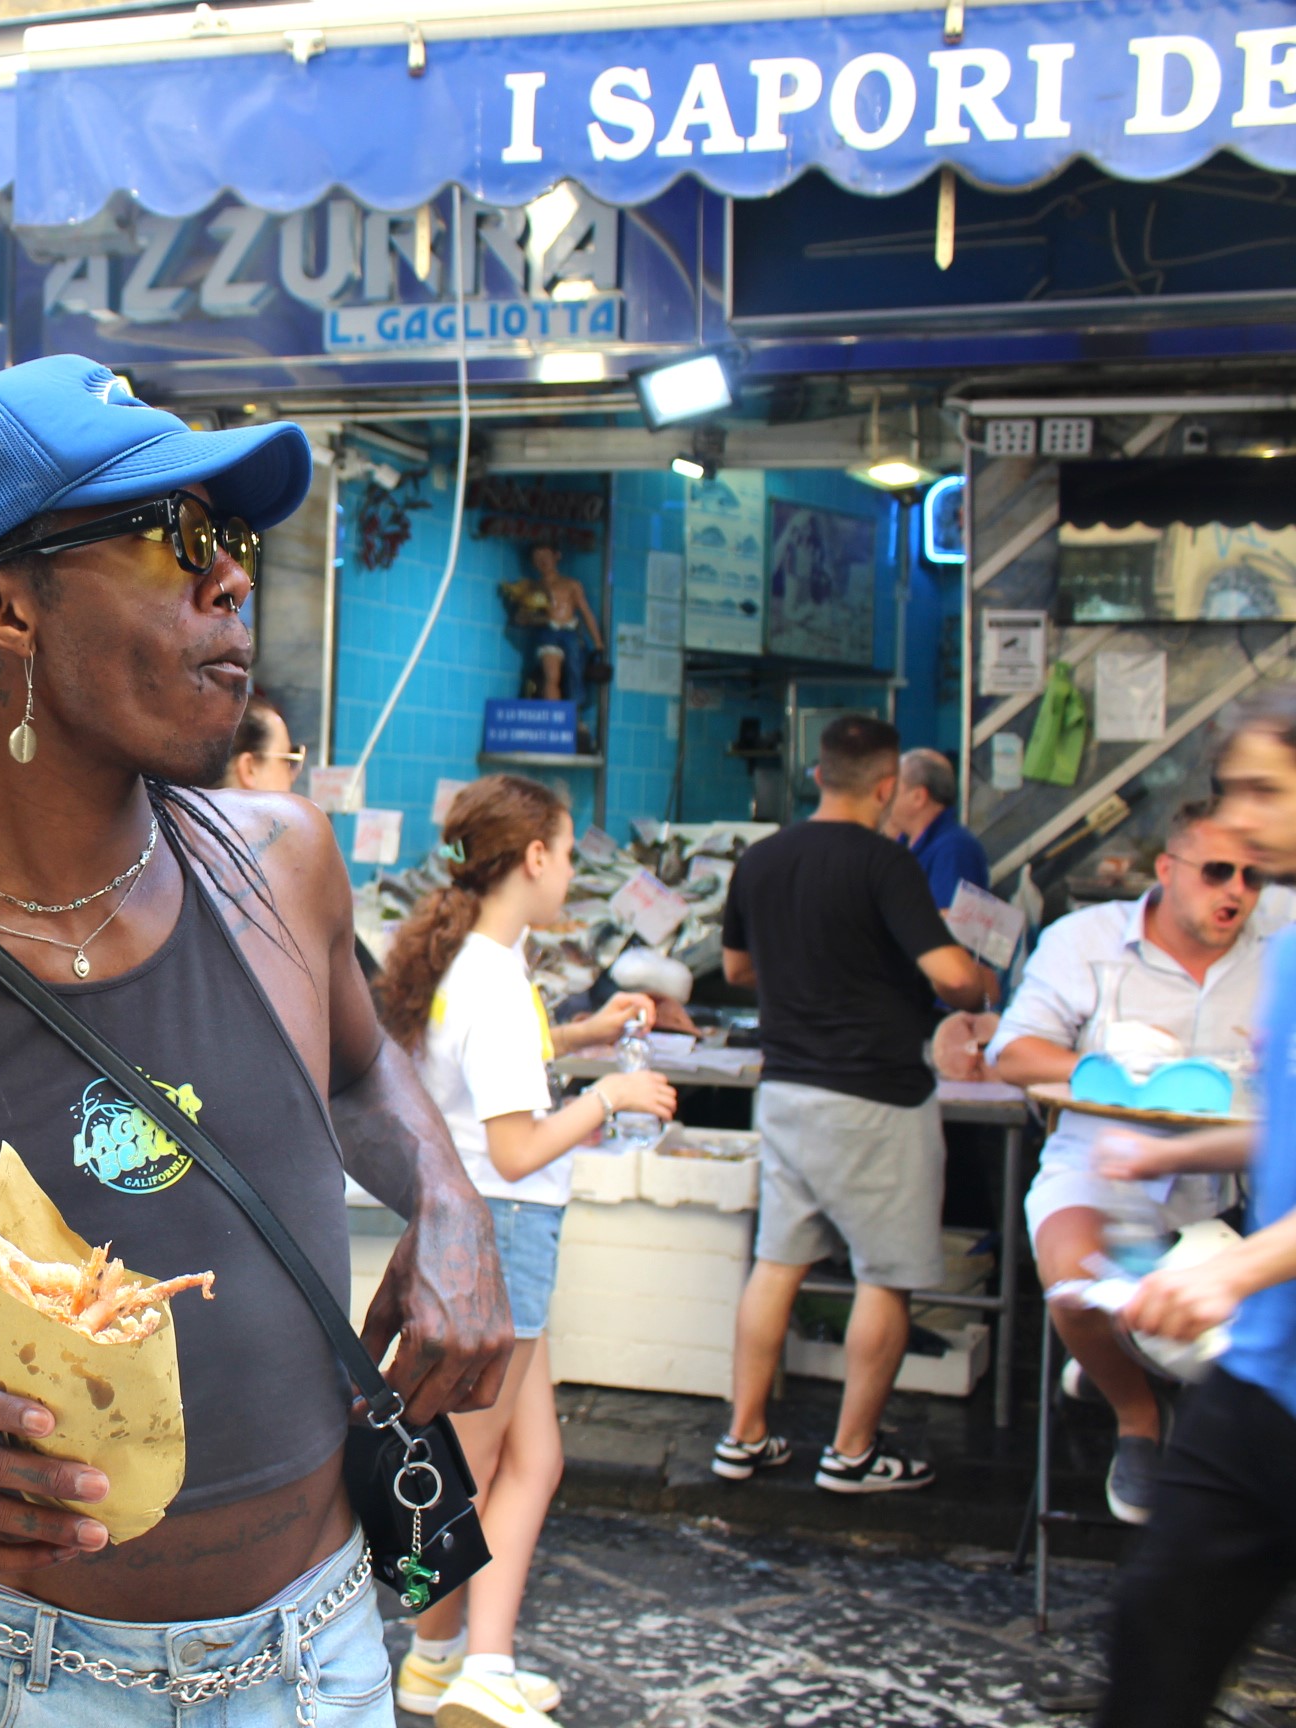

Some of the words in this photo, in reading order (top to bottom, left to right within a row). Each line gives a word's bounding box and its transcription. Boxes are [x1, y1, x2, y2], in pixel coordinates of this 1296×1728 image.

[501, 72, 546, 163] I
[587, 43, 1075, 161] SAPORI
[1124, 27, 1296, 134] DE
[330, 311, 365, 345] L.
[377, 301, 615, 342] GAGLIOTTA
[124, 1154, 188, 1188] CALIFORNIA
